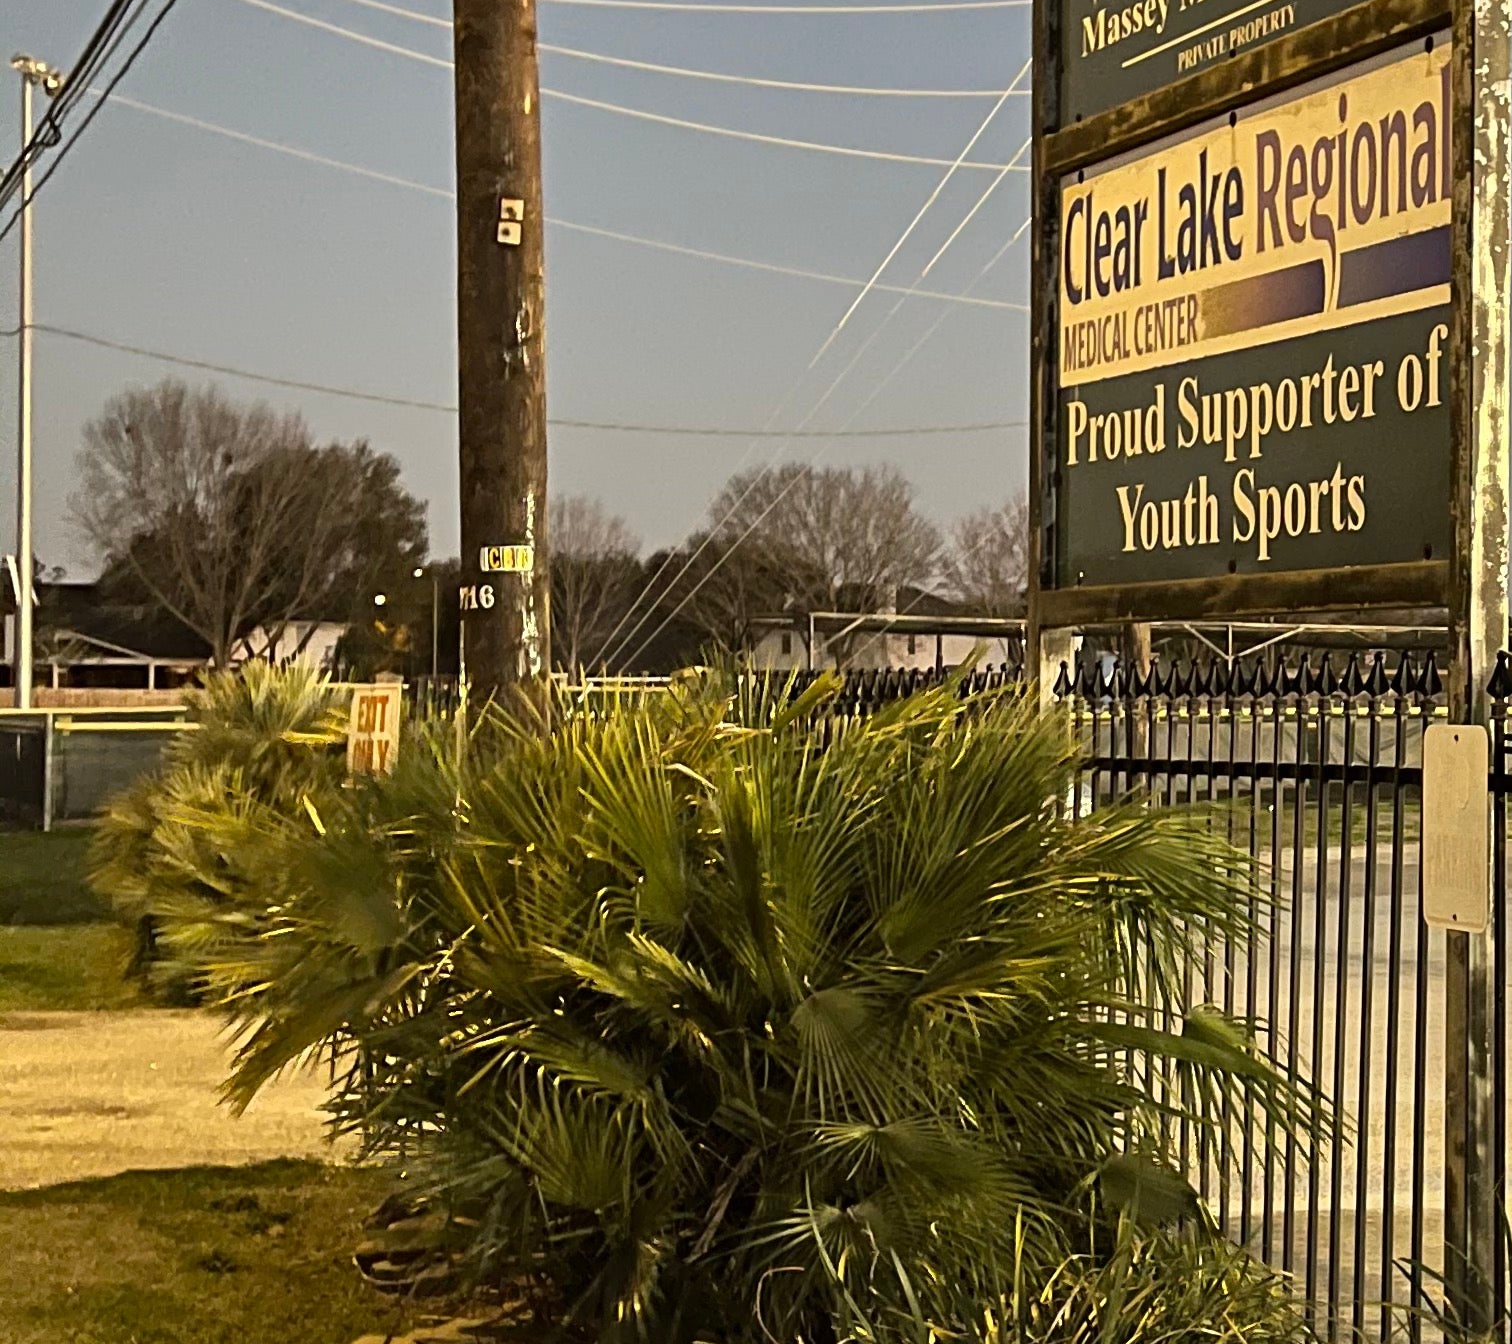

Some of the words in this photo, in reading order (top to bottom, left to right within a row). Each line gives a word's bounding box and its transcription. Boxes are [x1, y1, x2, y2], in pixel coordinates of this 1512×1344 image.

[1178, 33, 1227, 73] PRIVATE
[1229, 2, 1297, 49] PROPERTY
[1065, 189, 1148, 305] Clear
[1158, 148, 1244, 281] Lake
[1255, 64, 1453, 261] Regional
[1063, 309, 1130, 373] MEDICAL
[1133, 293, 1199, 356] CENTER
[1066, 384, 1165, 466] Proud
[1176, 352, 1384, 463] Supporter
[1397, 322, 1448, 413] of
[1115, 475, 1219, 553] Youth
[1232, 461, 1366, 561] Sports
[357, 696, 389, 732] EXIT
